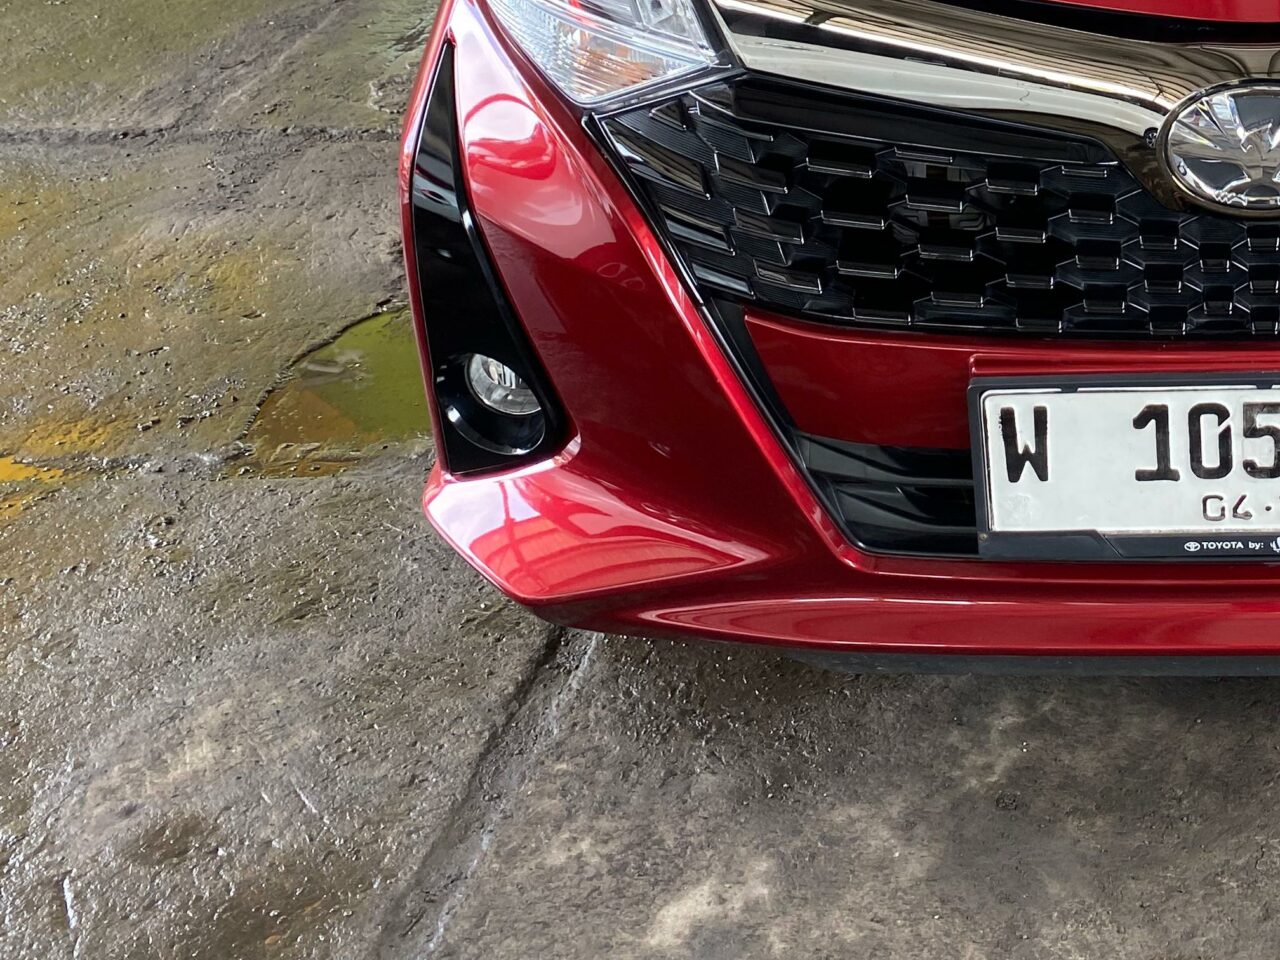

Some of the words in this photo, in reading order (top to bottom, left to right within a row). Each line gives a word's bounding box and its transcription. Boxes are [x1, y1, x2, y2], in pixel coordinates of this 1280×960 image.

[1000, 405, 1049, 483] W
[1201, 541, 1245, 550] TOYOTA
[1248, 540, 1264, 551] by:
